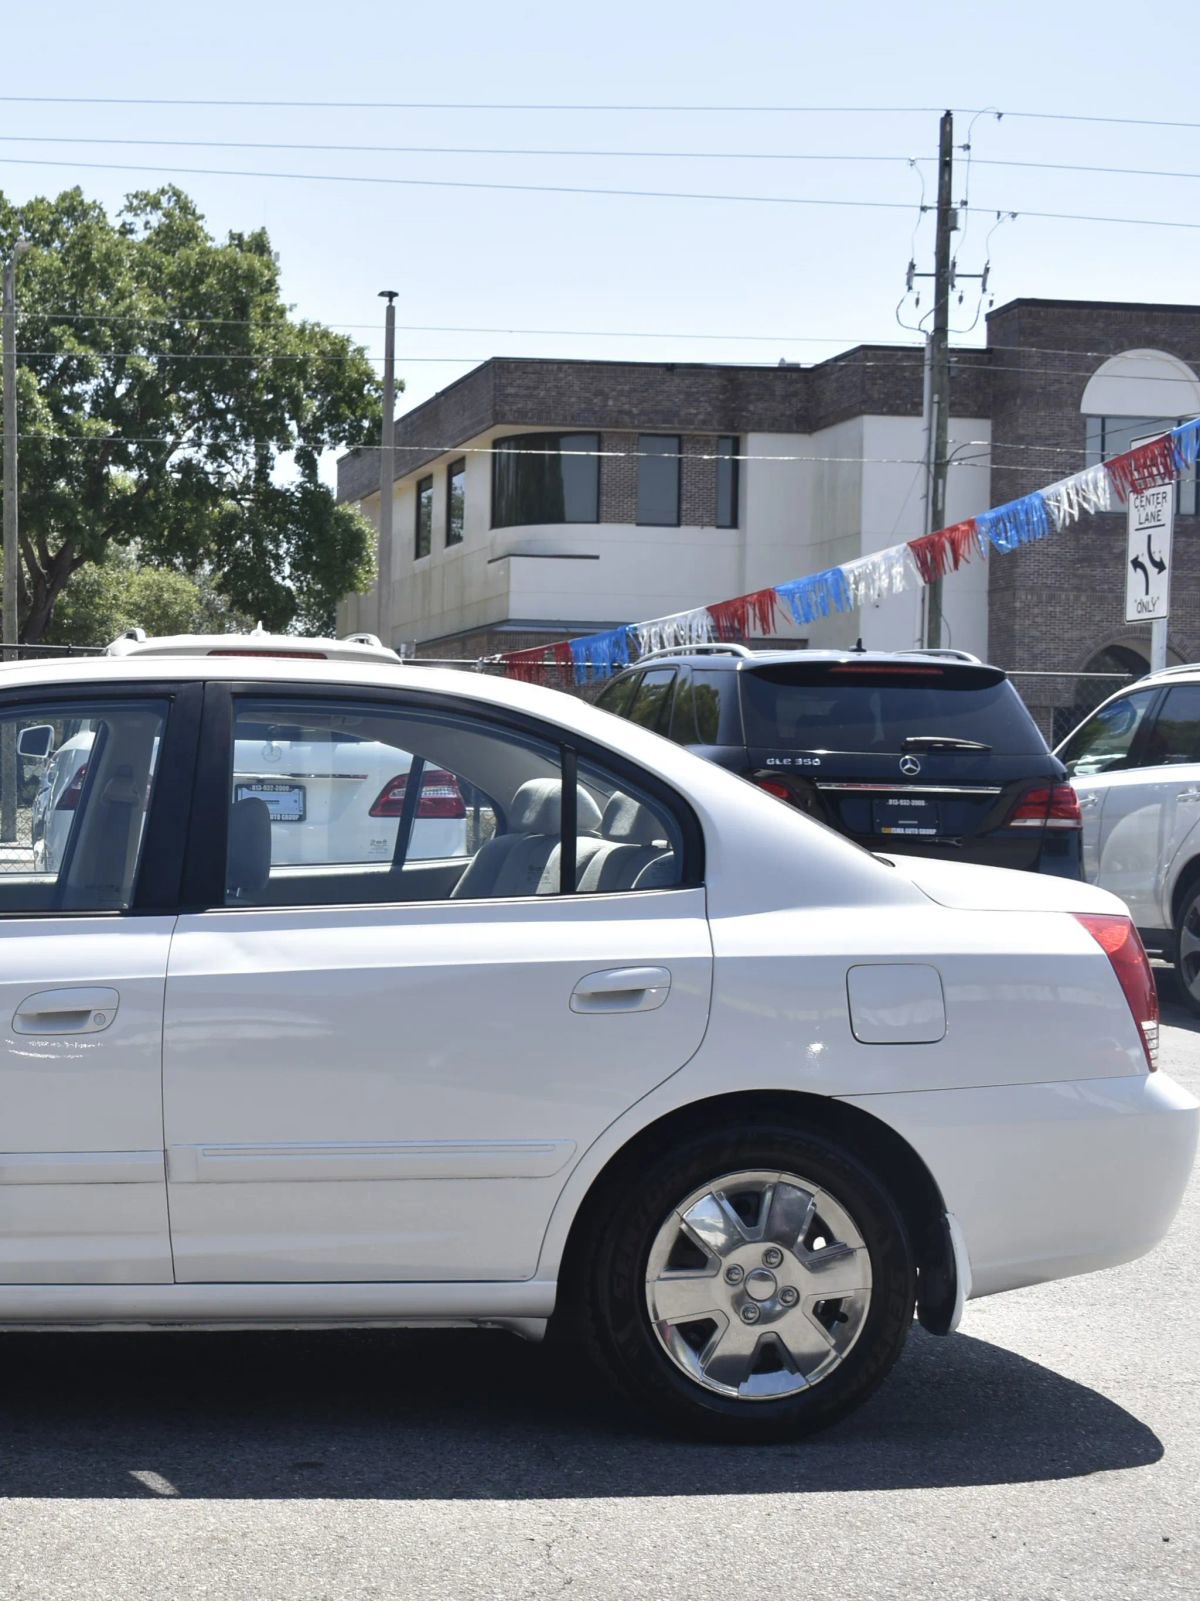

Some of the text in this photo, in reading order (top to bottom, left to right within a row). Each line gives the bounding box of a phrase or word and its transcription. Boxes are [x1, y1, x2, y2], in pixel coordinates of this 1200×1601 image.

[1133, 491, 1168, 508] CENTER
[1138, 509, 1163, 525] LANE
[1135, 596, 1160, 614] ONLY
[795, 758, 821, 766] 350
